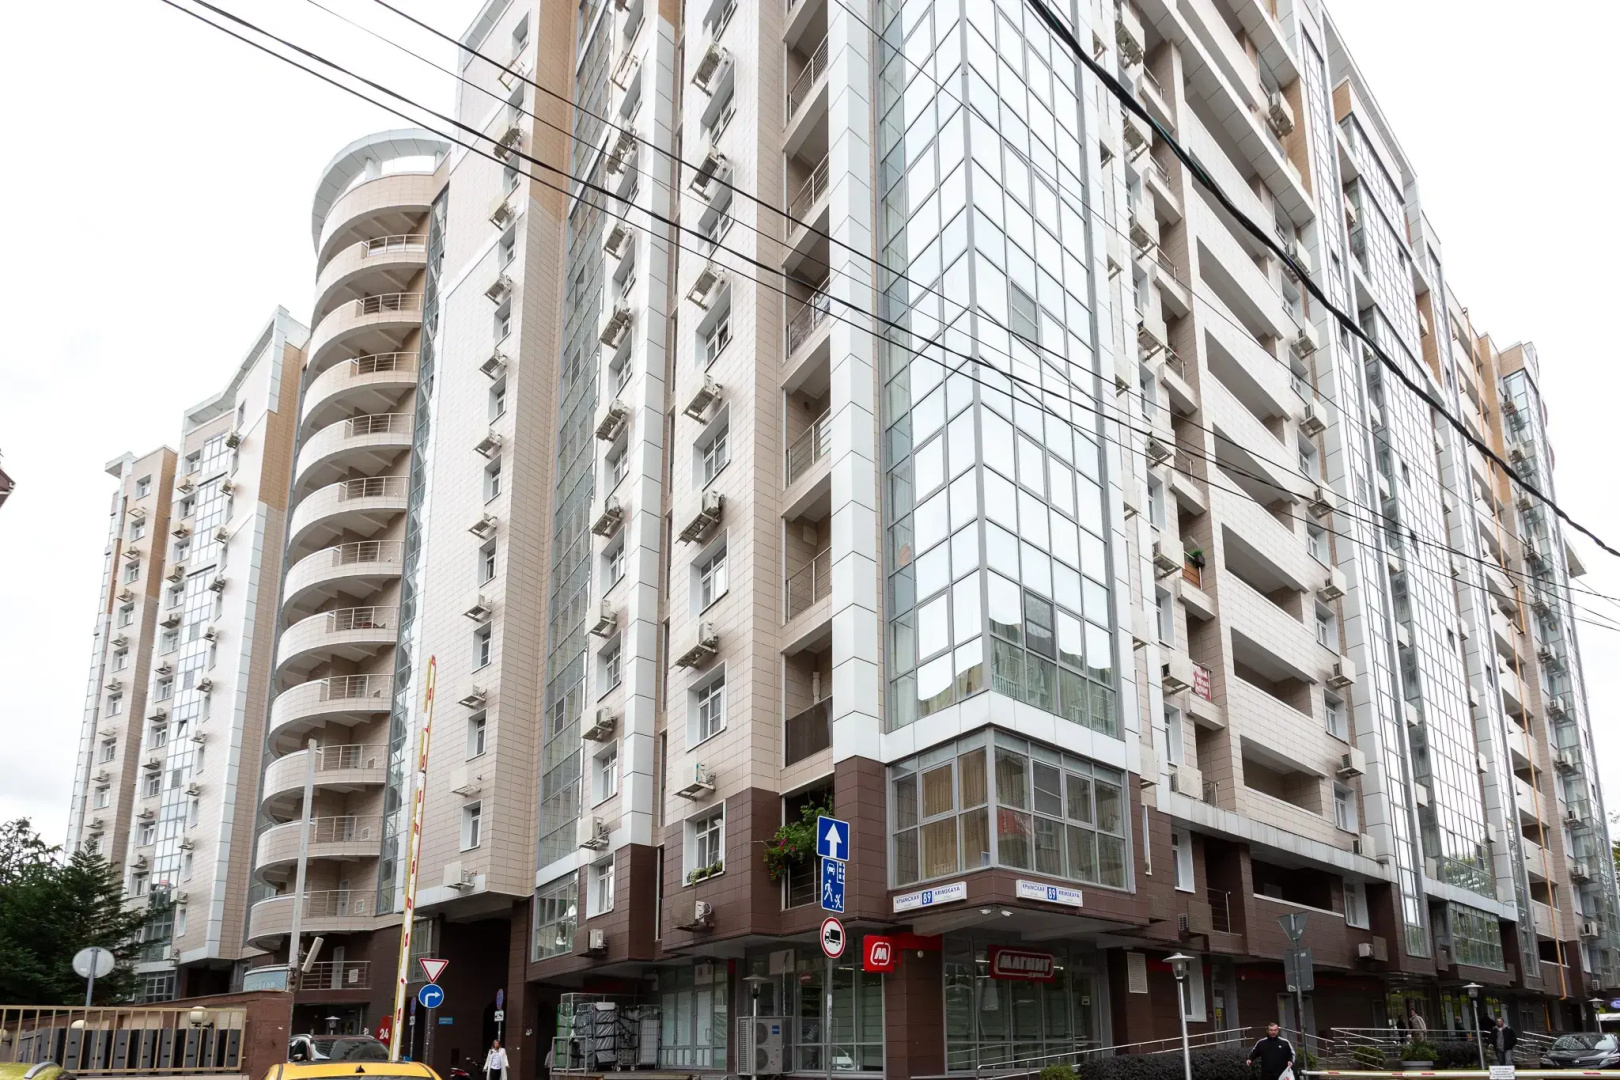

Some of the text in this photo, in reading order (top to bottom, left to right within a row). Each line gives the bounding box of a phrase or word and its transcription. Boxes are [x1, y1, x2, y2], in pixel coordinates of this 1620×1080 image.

[922, 891, 932, 904] 89
[1048, 887, 1056, 900] 89
[998, 954, 1051, 972] МАГНИТ
[379, 1027, 390, 1040] 24
